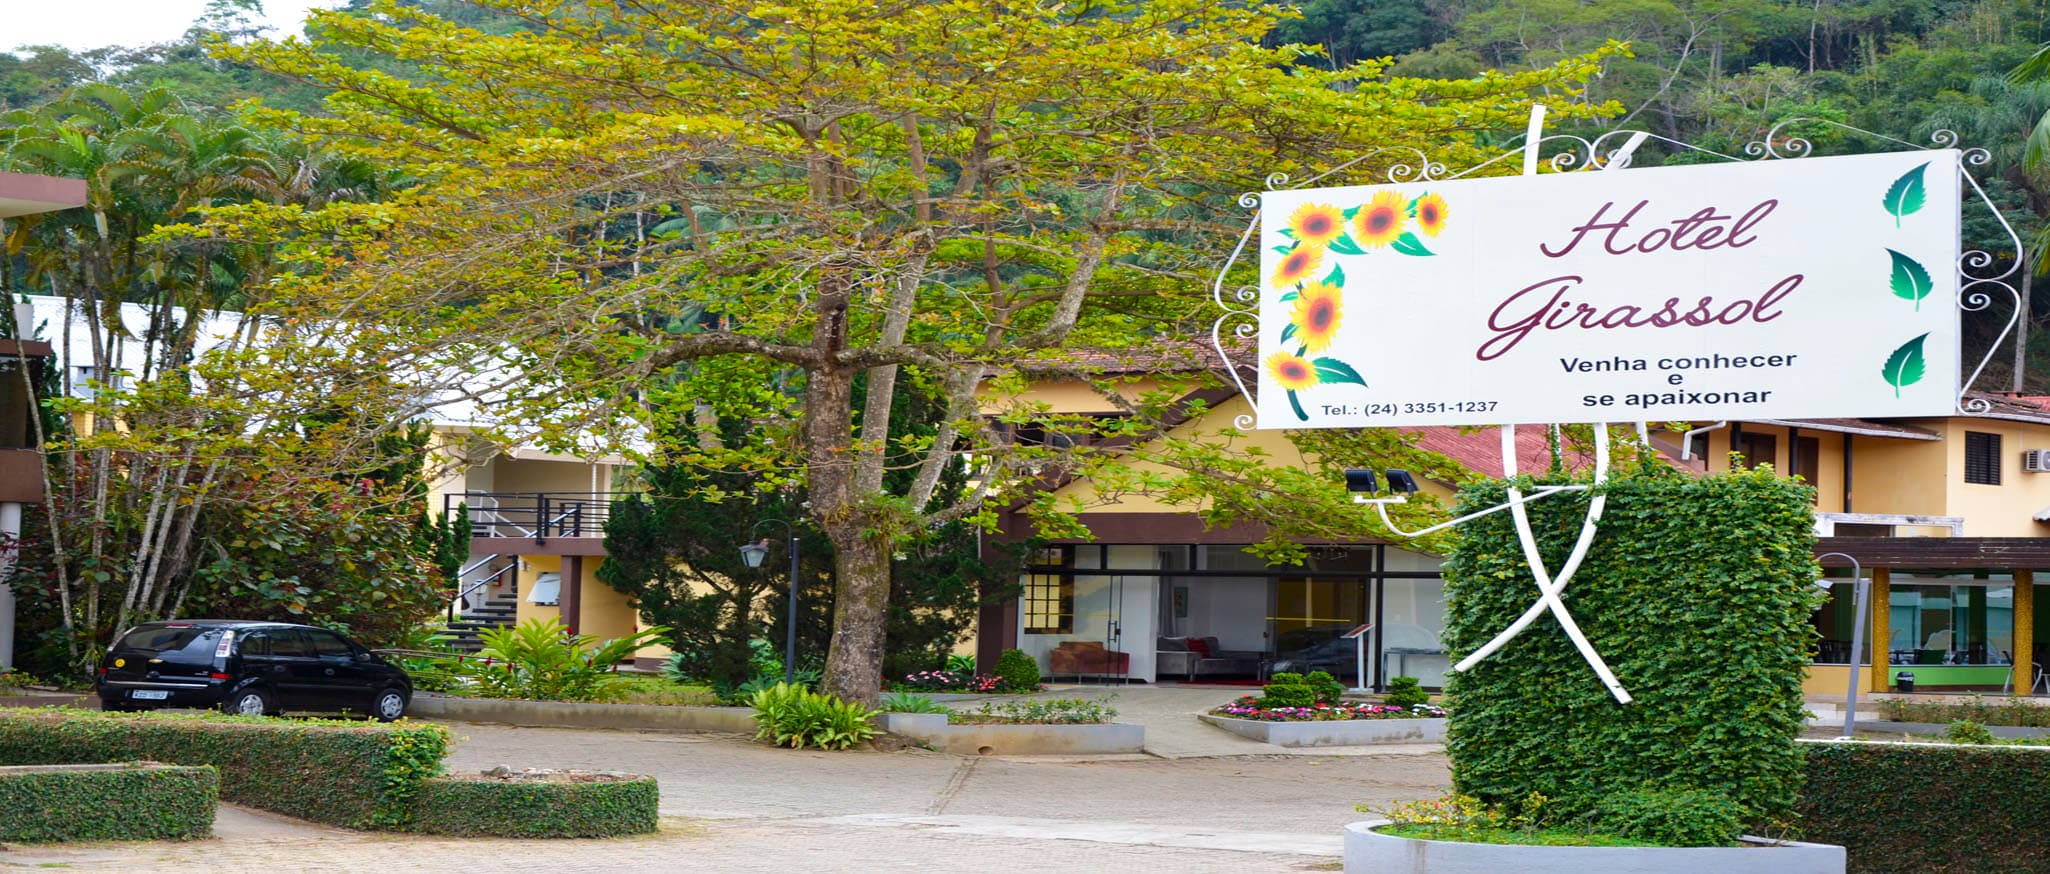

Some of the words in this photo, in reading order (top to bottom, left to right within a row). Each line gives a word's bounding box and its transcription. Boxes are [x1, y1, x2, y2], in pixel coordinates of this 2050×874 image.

[1539, 199, 1778, 258] Hotel
[1476, 273, 1805, 363] Girassol
[1559, 356, 1647, 373] Venha
[1657, 353, 1798, 371] conhecer
[1667, 373, 1684, 386] e
[1321, 404, 1358, 416] Tel.:
[1364, 403, 1398, 417] (24)
[1404, 401, 1498, 414] 3351-1237
[1583, 394, 1615, 407] se
[1624, 389, 1772, 409] apaixonar
